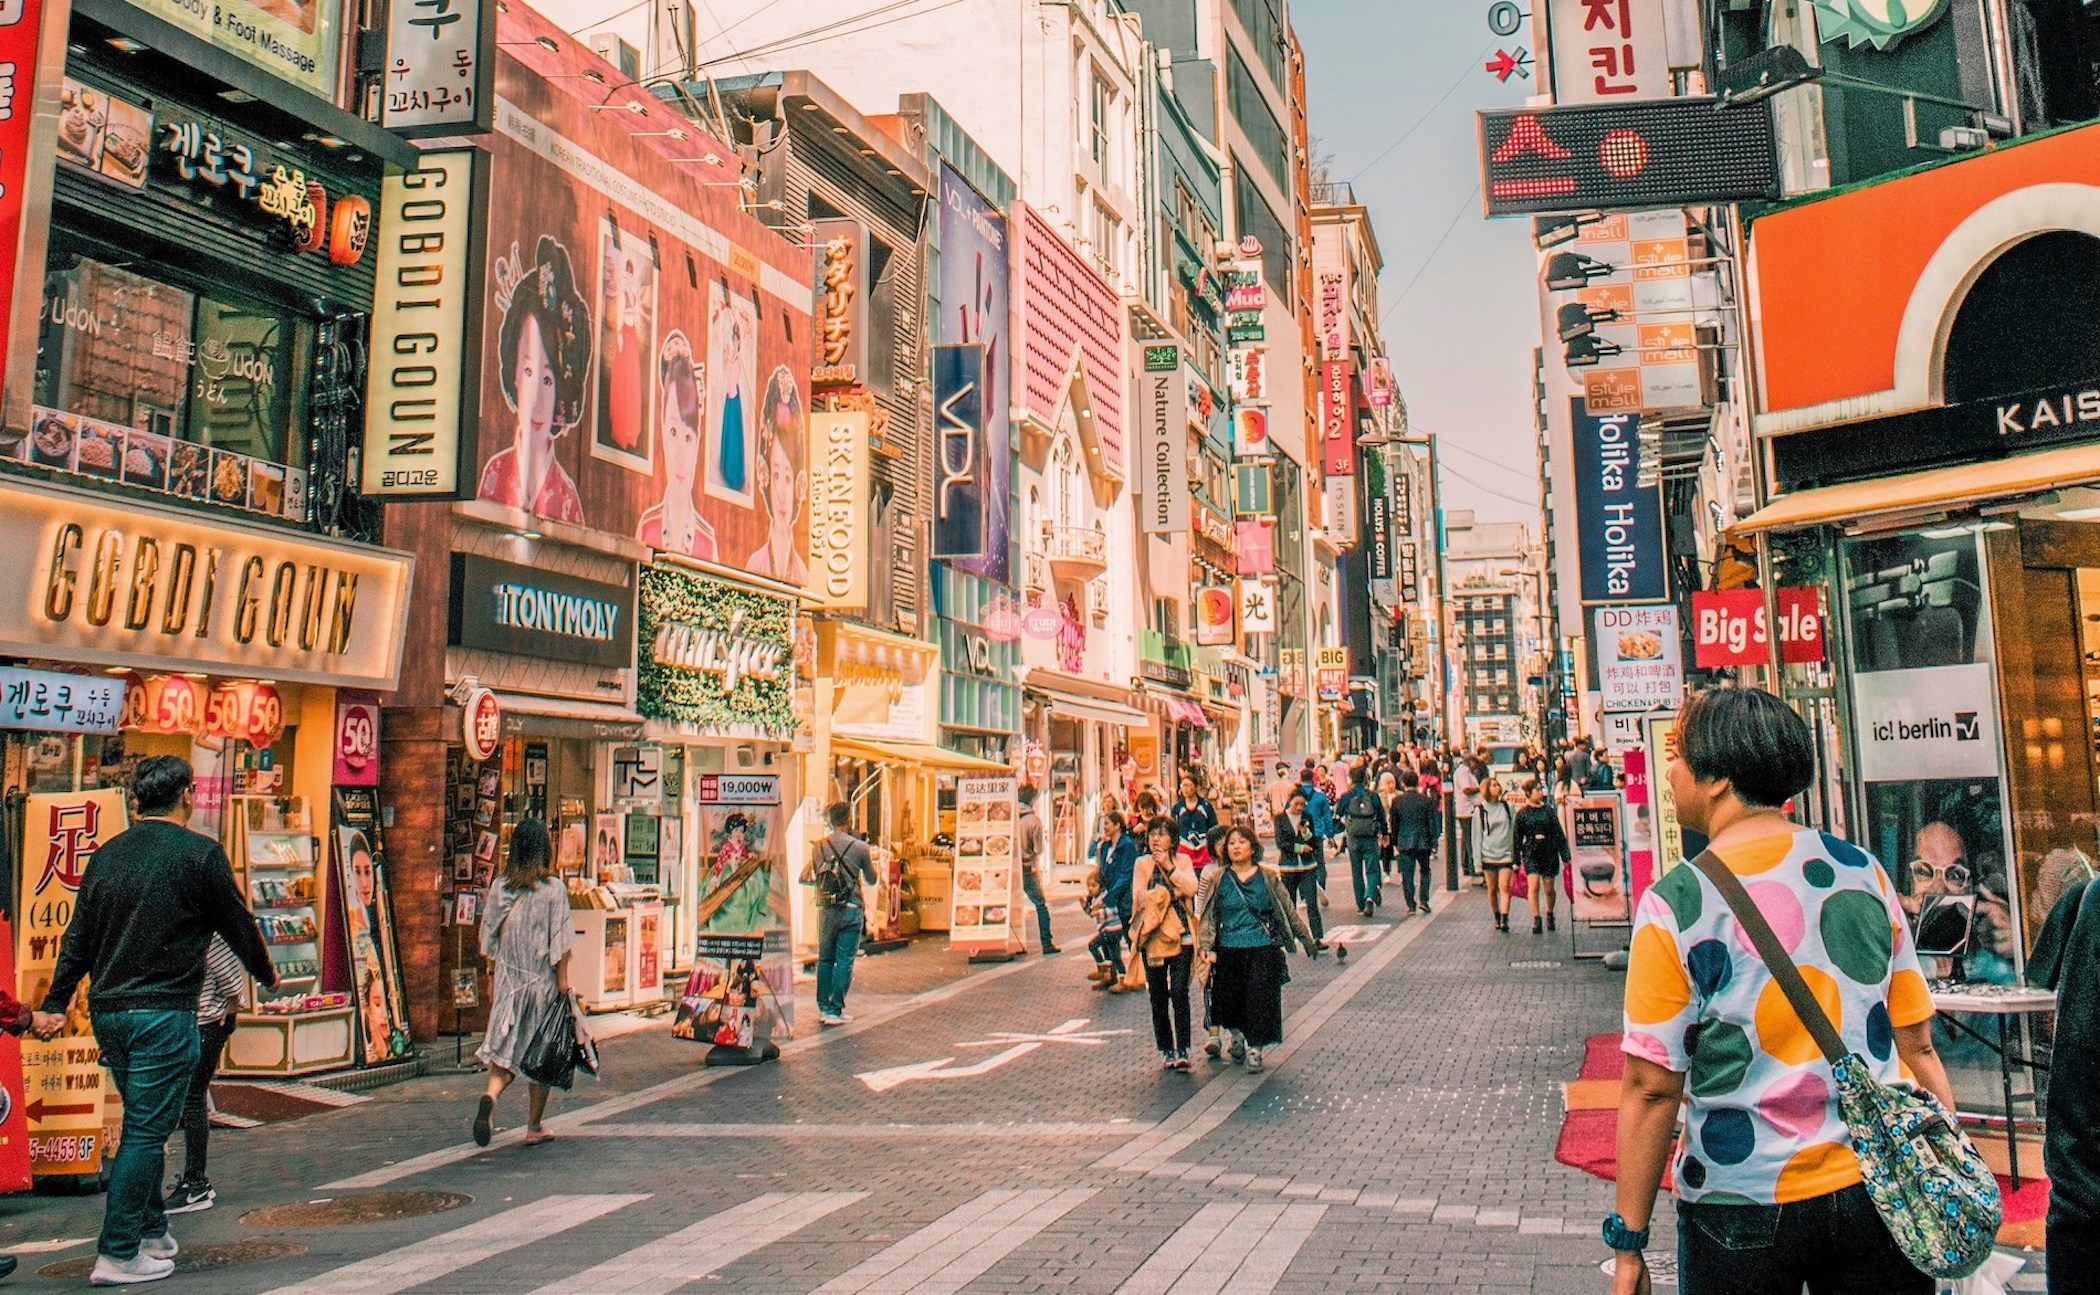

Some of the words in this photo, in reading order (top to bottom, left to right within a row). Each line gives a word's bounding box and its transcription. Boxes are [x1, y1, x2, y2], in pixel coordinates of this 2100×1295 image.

[214, 5, 222, 25] &
[226, 13, 258, 44] Foot
[260, 29, 316, 74] Massage
[1581, 0, 1637, 95] 치킨
[389, 87, 473, 113] 꼬치구이
[169, 122, 258, 199] 겐로쿠
[396, 166, 448, 311] GOBDI
[1583, 226, 1623, 240] mall
[1639, 264, 1685, 278] mall
[1226, 288, 1265, 308] Mud
[1645, 346, 1692, 361] mall
[388, 331, 439, 456] GOUN
[1590, 379, 1636, 396] style
[1591, 393, 1637, 408] mall
[1154, 376, 1171, 436] Nature
[1997, 391, 2100, 434] KAIS
[1327, 419, 1341, 440] 2
[940, 381, 975, 520] VDL
[1335, 459, 1350, 472] 3F
[381, 468, 439, 487] 곱디고운
[1154, 441, 1171, 526] Collection
[827, 423, 854, 598] SKINFOOD
[1373, 498, 1385, 533] HOLLYS
[1373, 542, 1386, 577] COFFEE
[1604, 503, 1637, 595] Holika
[44, 523, 223, 639] GOBDI
[232, 554, 359, 655] GOUN
[1244, 592, 1268, 620] 光
[502, 584, 619, 642] TONYMOLY
[1028, 617, 1058, 629] ETUDE
[1603, 610, 1632, 628] DD
[1699, 607, 1748, 654] Big
[1752, 603, 1818, 643] Sale
[964, 633, 998, 674] VDL
[1321, 651, 1344, 664] BIG
[1320, 670, 1345, 685] MART
[1606, 663, 1676, 681] 炸鸡和啤酒
[1612, 682, 1639, 695] 可以
[1645, 680, 1672, 694] 打包
[8, 679, 74, 723] 겐로쿠
[88, 688, 111, 708] 우동
[159, 689, 194, 728] 50
[207, 692, 238, 731] 50
[250, 695, 281, 734] 50
[343, 716, 372, 755] 50
[1872, 721, 1895, 742] ic!
[1899, 717, 1952, 741] berlin
[35, 799, 101, 895] 足
[78, 1135, 96, 1160] 3F
